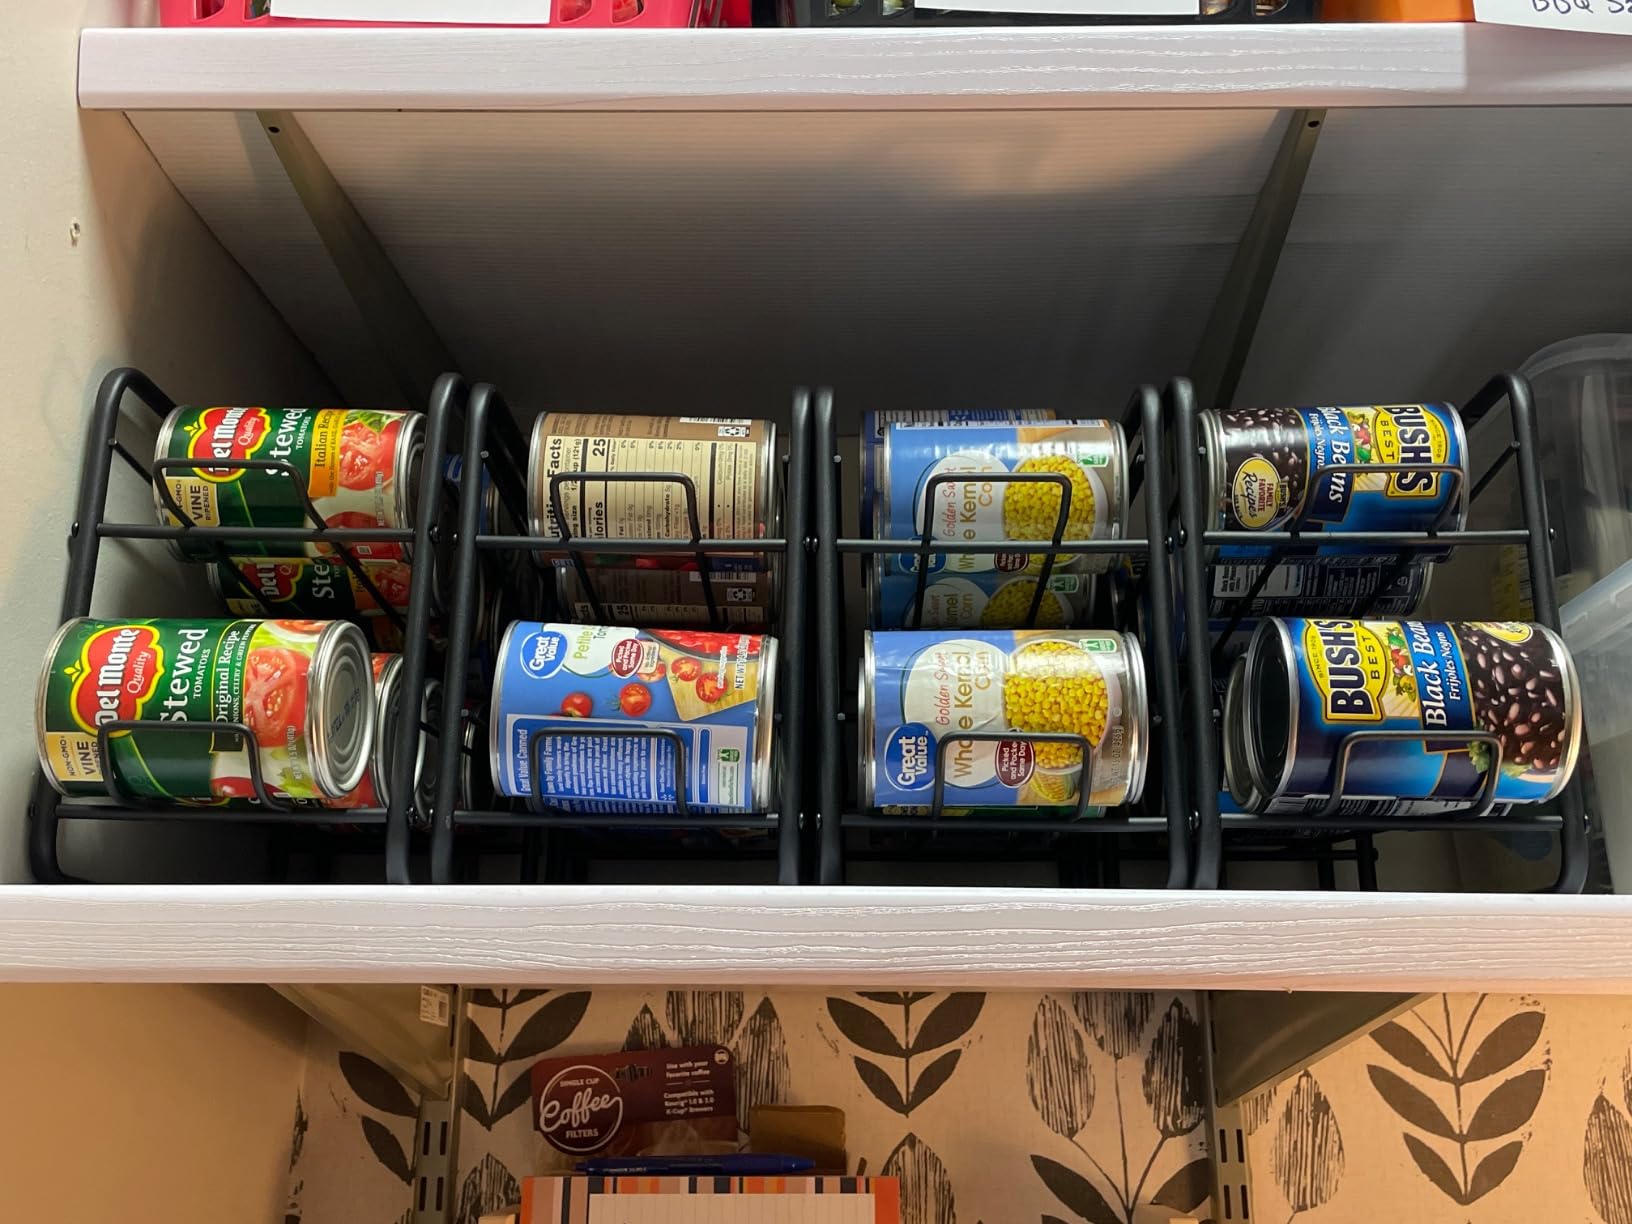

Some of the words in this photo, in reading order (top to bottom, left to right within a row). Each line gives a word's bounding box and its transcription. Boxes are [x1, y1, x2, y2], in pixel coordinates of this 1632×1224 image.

[314, 430, 328, 468] Italian
[573, 438, 581, 460] (121g)
[592, 438, 606, 457] 25
[1381, 420, 1395, 460] BEST
[547, 438, 561, 477] Facts
[190, 485, 203, 521] VINE
[203, 485, 211, 521] RIPENED
[1240, 471, 1268, 519] Recipes
[1257, 478, 1265, 513] FAVORITE
[1266, 482, 1274, 507] FAMILY
[942, 502, 957, 537] Golden
[98, 628, 140, 687] Monte
[219, 630, 240, 664] Recipe
[529, 635, 550, 671] Great
[545, 636, 560, 662] Value
[574, 631, 593, 660] Petite
[1310, 635, 1318, 650] 1908
[1361, 635, 1381, 681] BEST
[1436, 631, 1454, 659] Negros
[126, 649, 152, 694] Quality
[193, 649, 210, 700] TOMATOES
[233, 669, 241, 695] CELERY
[735, 663, 745, 674] WT
[735, 675, 744, 690] NET
[1313, 652, 1325, 679] SINCE
[1316, 620, 1375, 715] BUSH'S
[1441, 660, 1462, 701] Frijoles
[934, 685, 950, 726] Golden
[1417, 660, 1447, 727] Black
[76, 740, 96, 776] VINE
[517, 728, 528, 759] Canned
[897, 735, 917, 786] Great
[915, 736, 929, 776] Value
[1001, 747, 1010, 772] Picked
[1010, 741, 1018, 766] Packe
[1018, 741, 1027, 757] Day
[518, 759, 529, 778] Value
[544, 756, 554, 775] Family
[1010, 767, 1018, 780] and
[1017, 757, 1026, 777] Same
[559, 1077, 584, 1088] SINGLE
[585, 1076, 601, 1086] CUP
[539, 1087, 622, 1134] Coffee
[565, 1127, 599, 1139] FILTERS
